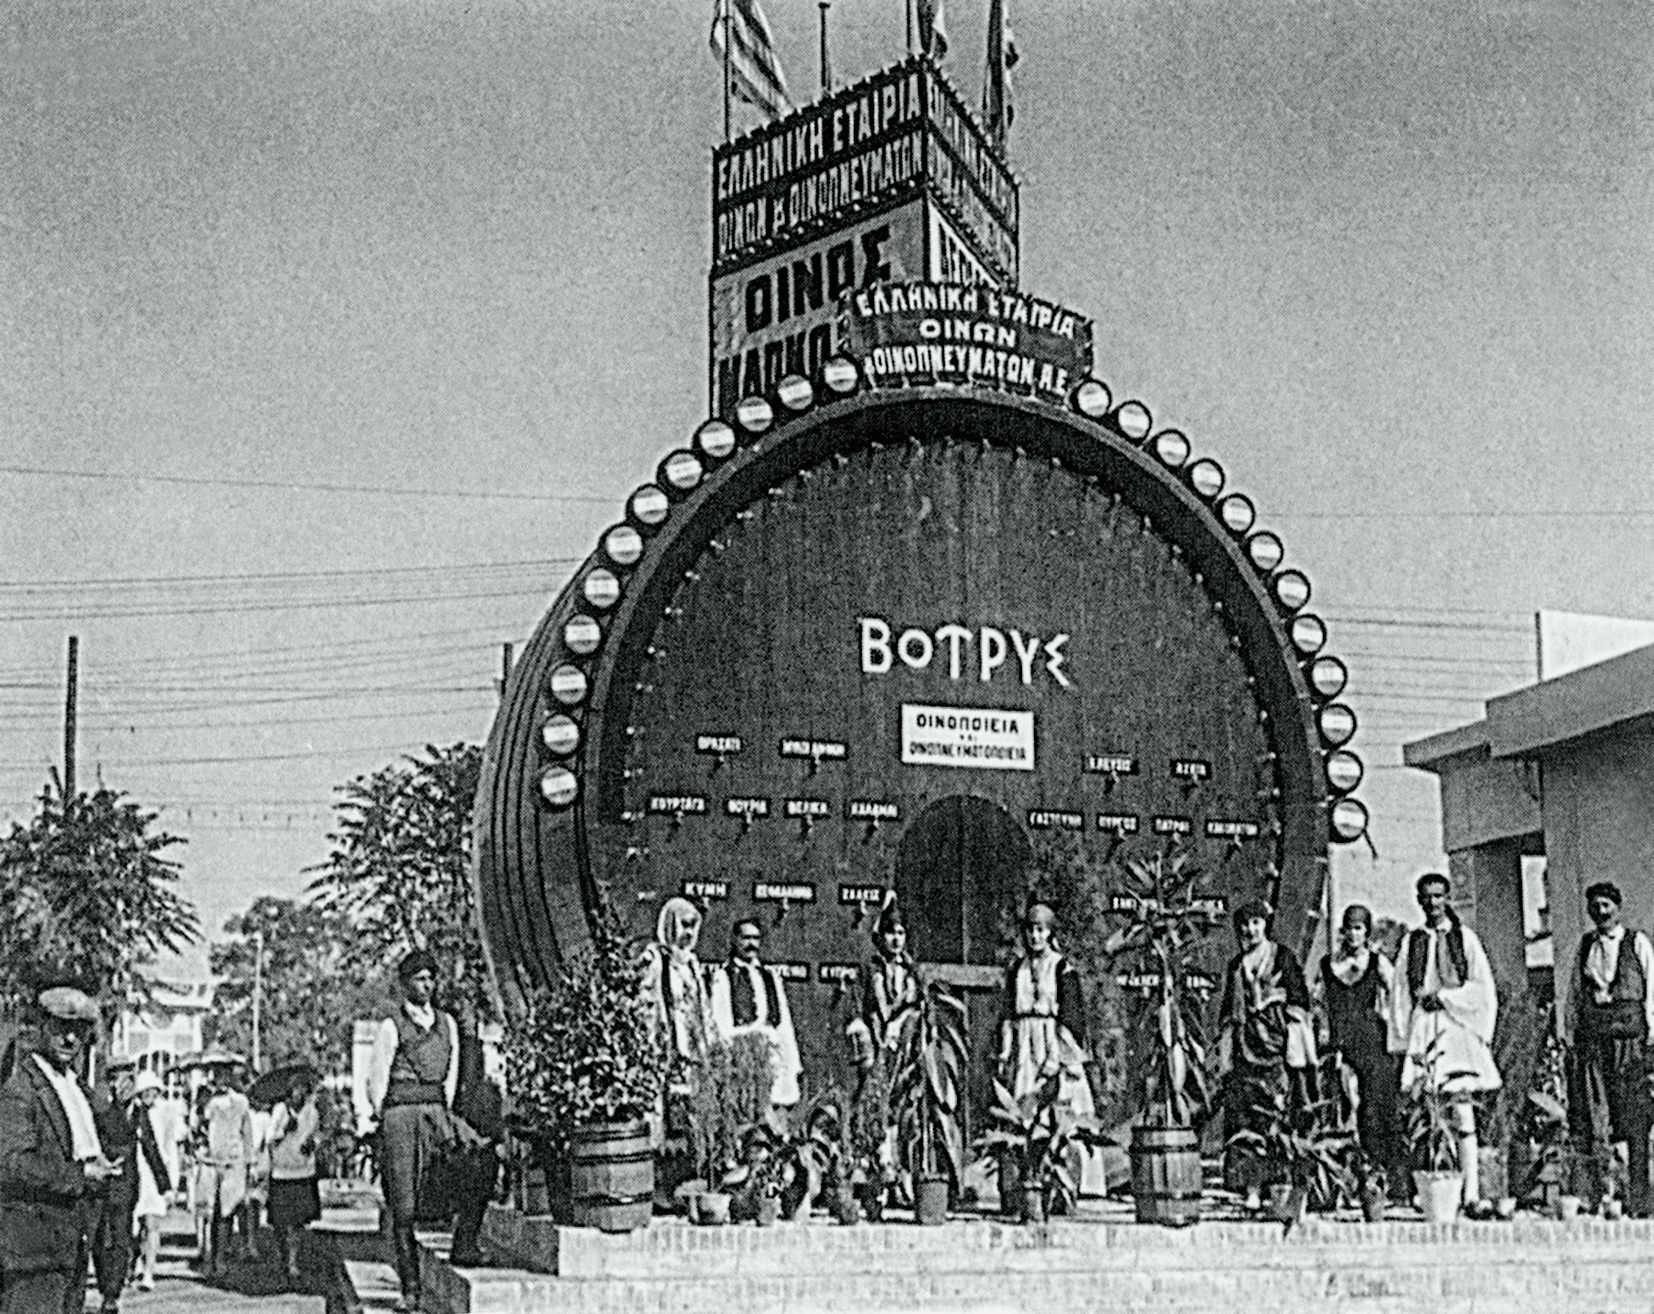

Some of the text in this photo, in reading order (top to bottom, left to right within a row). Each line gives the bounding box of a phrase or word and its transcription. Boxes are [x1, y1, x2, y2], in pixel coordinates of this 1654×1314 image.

[718, 117, 824, 200] ΕΛΛΗΝΙΚΗ
[833, 73, 921, 153] ΕΤΑΙΡΙΑ
[745, 224, 891, 334] ΟΙΝΟΣ
[856, 283, 1075, 340] ΕΛΛΗΝΙΚΗ ΕΤΑΙΡΙΑ
[919, 318, 1016, 348] ΟΙΝΩΝ
[860, 617, 1071, 687] ΒΟΤΡΥΣ
[916, 713, 1019, 735] ΟΙΝΟΠΟΙΕΙΑ
